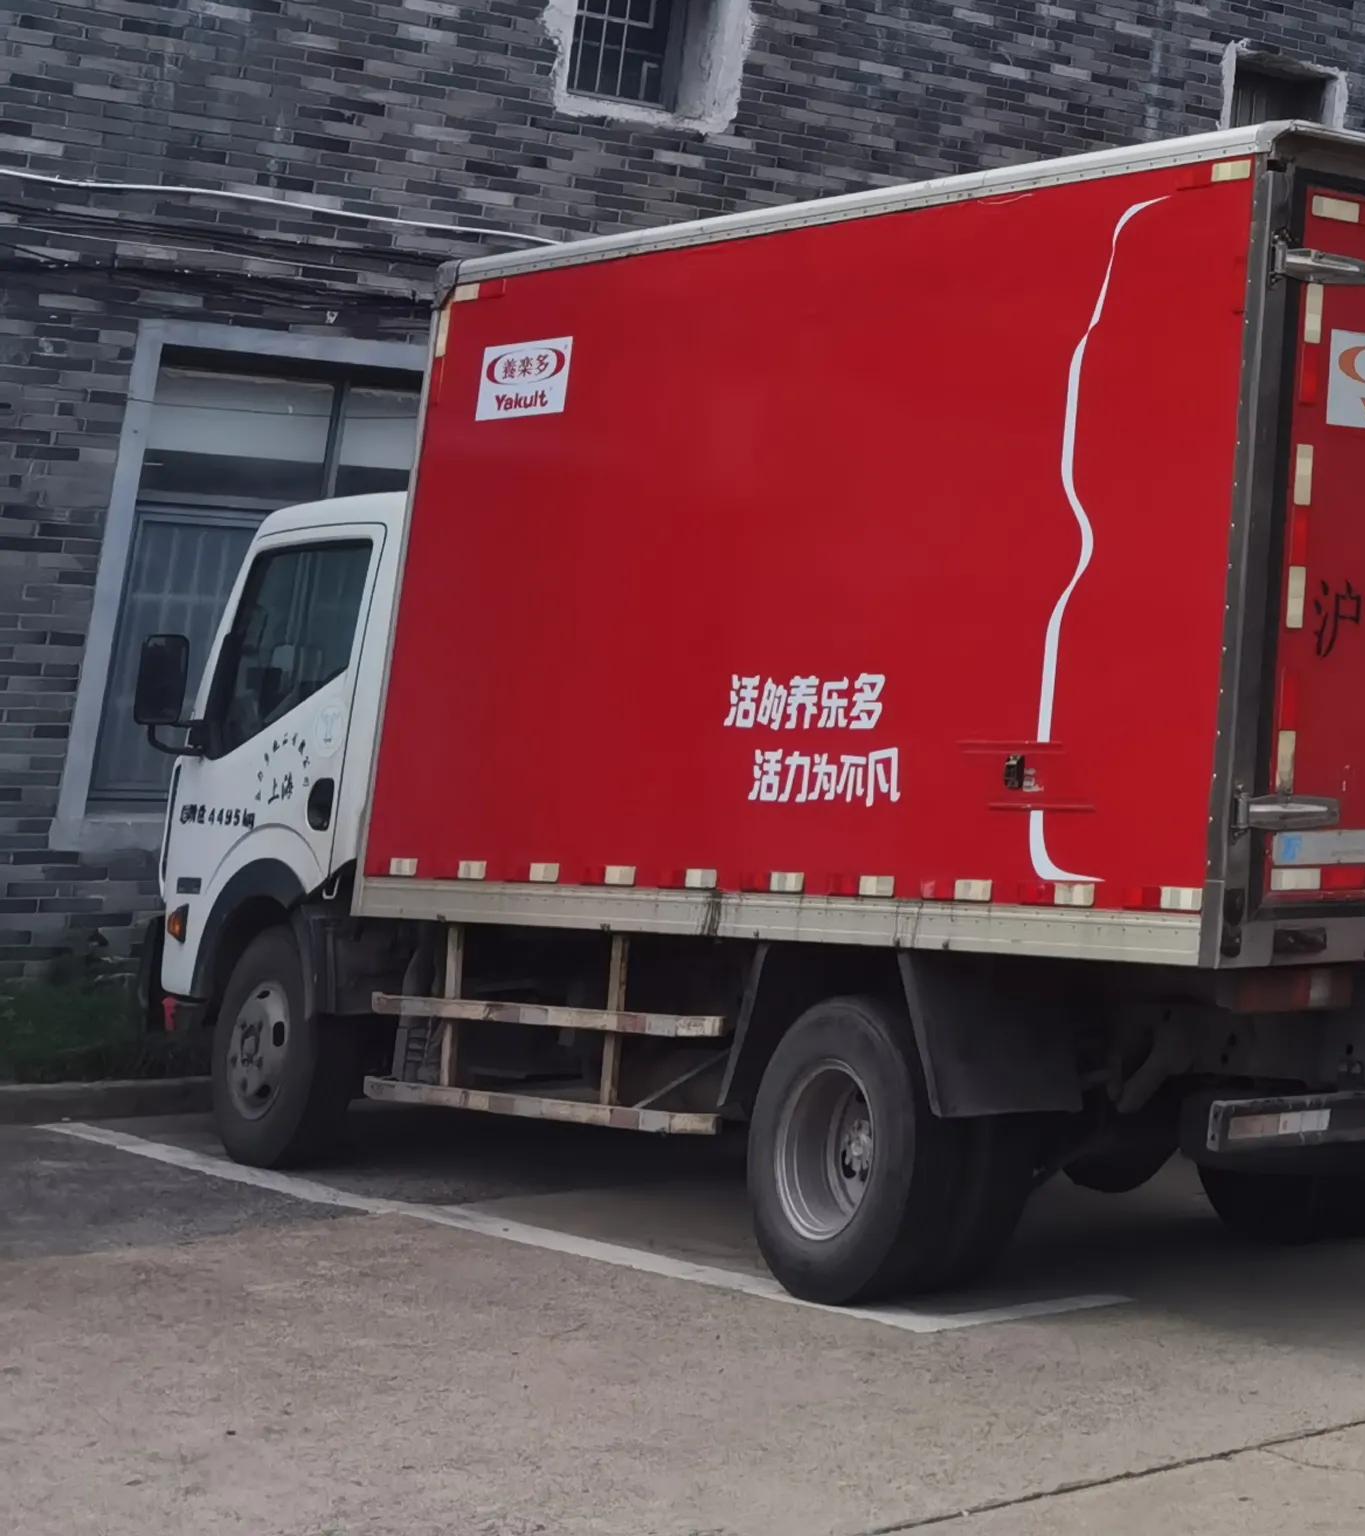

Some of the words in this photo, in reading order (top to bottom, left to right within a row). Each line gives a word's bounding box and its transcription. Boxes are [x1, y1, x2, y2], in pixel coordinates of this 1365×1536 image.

[495, 390, 549, 411] Yakult
[723, 672, 886, 731] 活的养乐多
[747, 746, 901, 808] 活力为不凡
